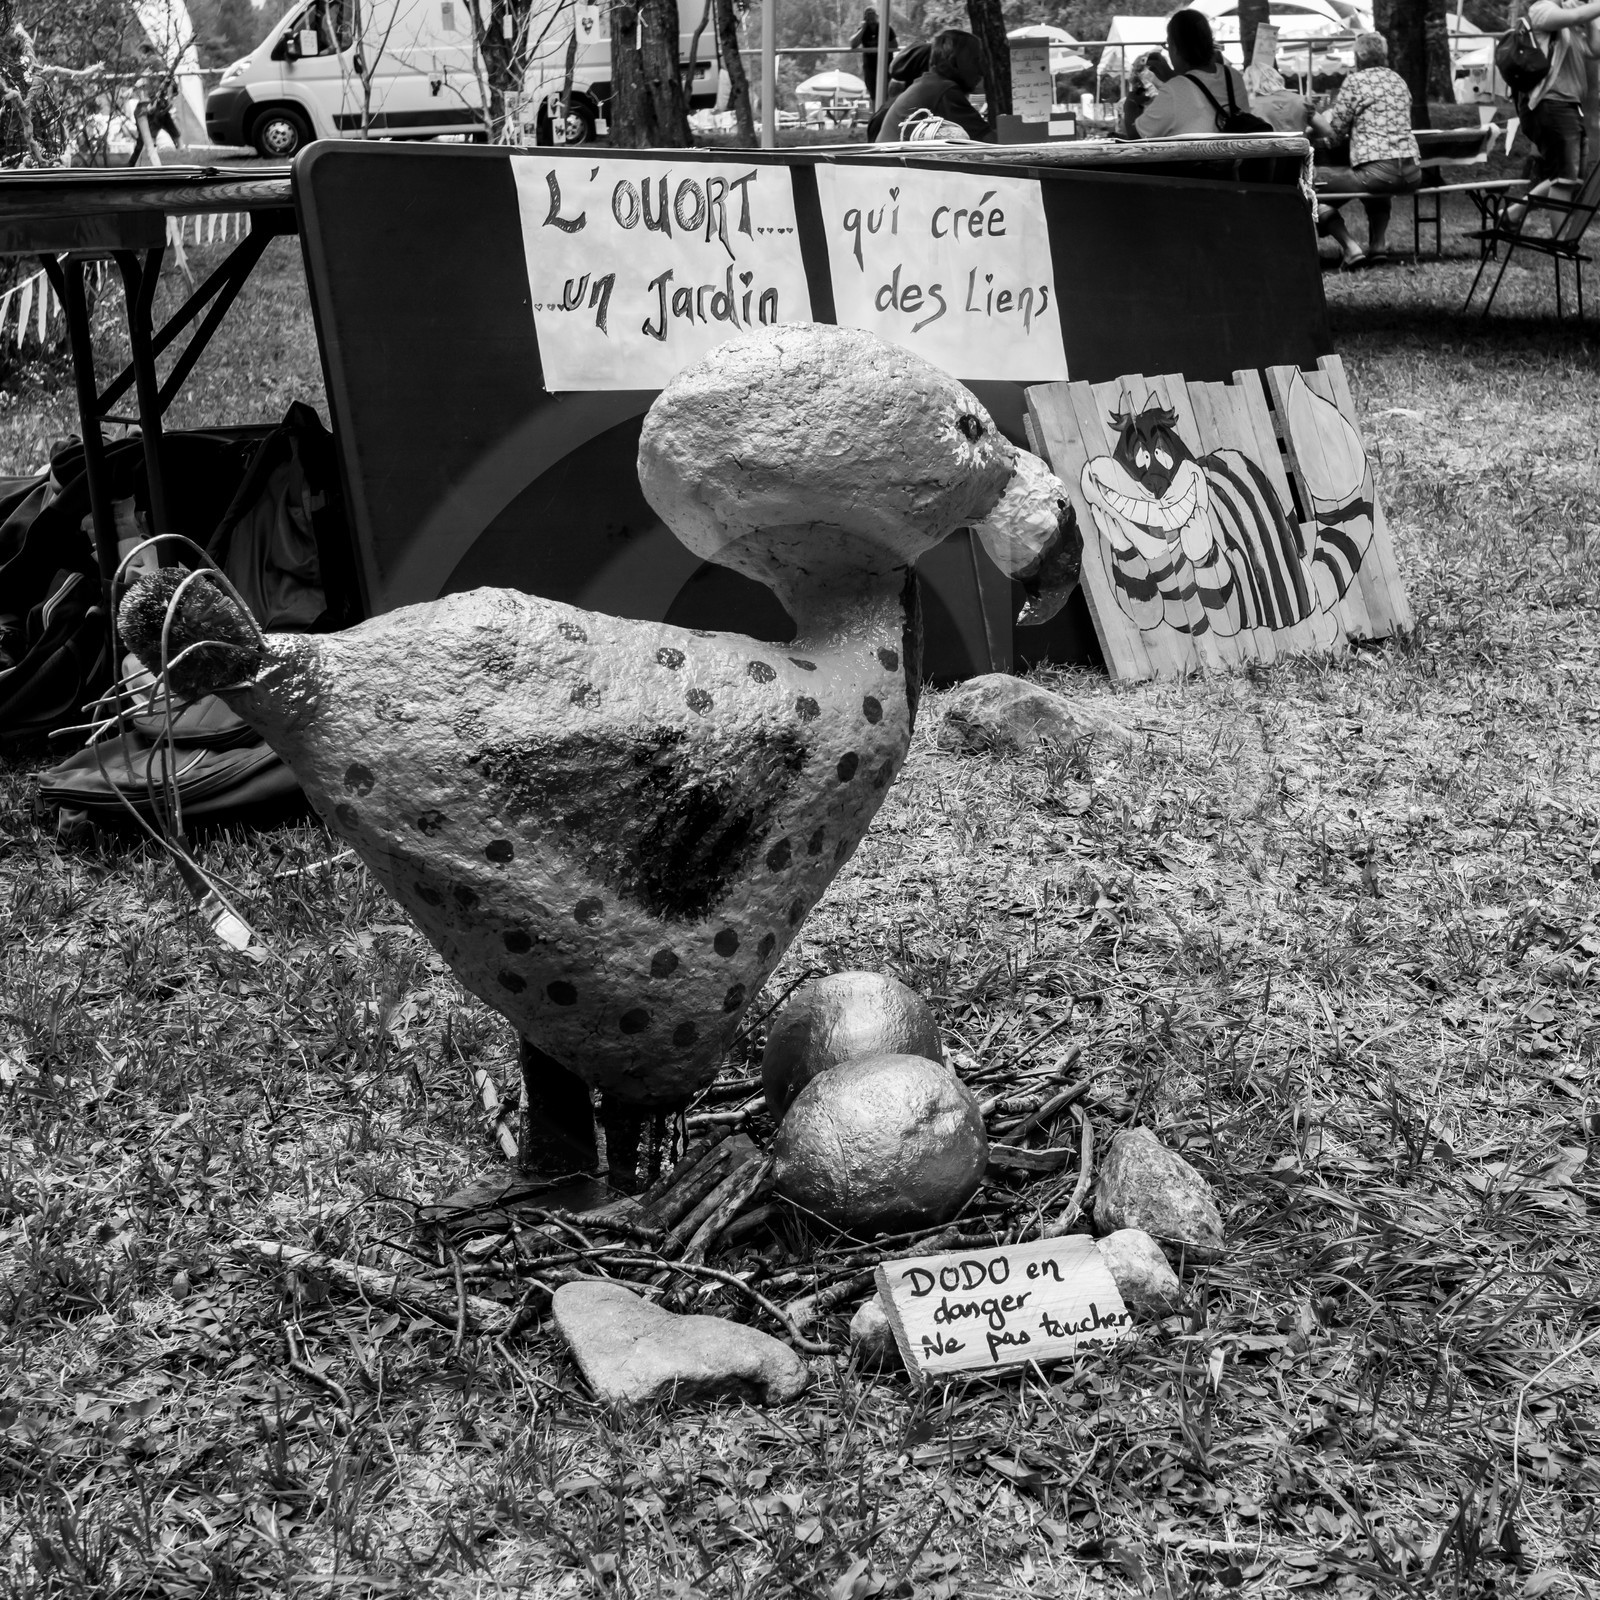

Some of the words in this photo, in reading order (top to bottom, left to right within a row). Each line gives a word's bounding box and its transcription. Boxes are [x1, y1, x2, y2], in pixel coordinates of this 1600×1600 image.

[843, 186, 900, 273] qui
[931, 190, 1007, 243] crée
[642, 263, 779, 342] Jardin
[875, 263, 947, 334] des
[965, 266, 1049, 336] Liens
[901, 1256, 1010, 1297] DODO
[1026, 1258, 1065, 1283] en
[921, 1331, 966, 1360] Ne
[986, 1330, 1031, 1363] pas
[1039, 1302, 1131, 1338] toucher
[933, 1291, 1032, 1331] danger
